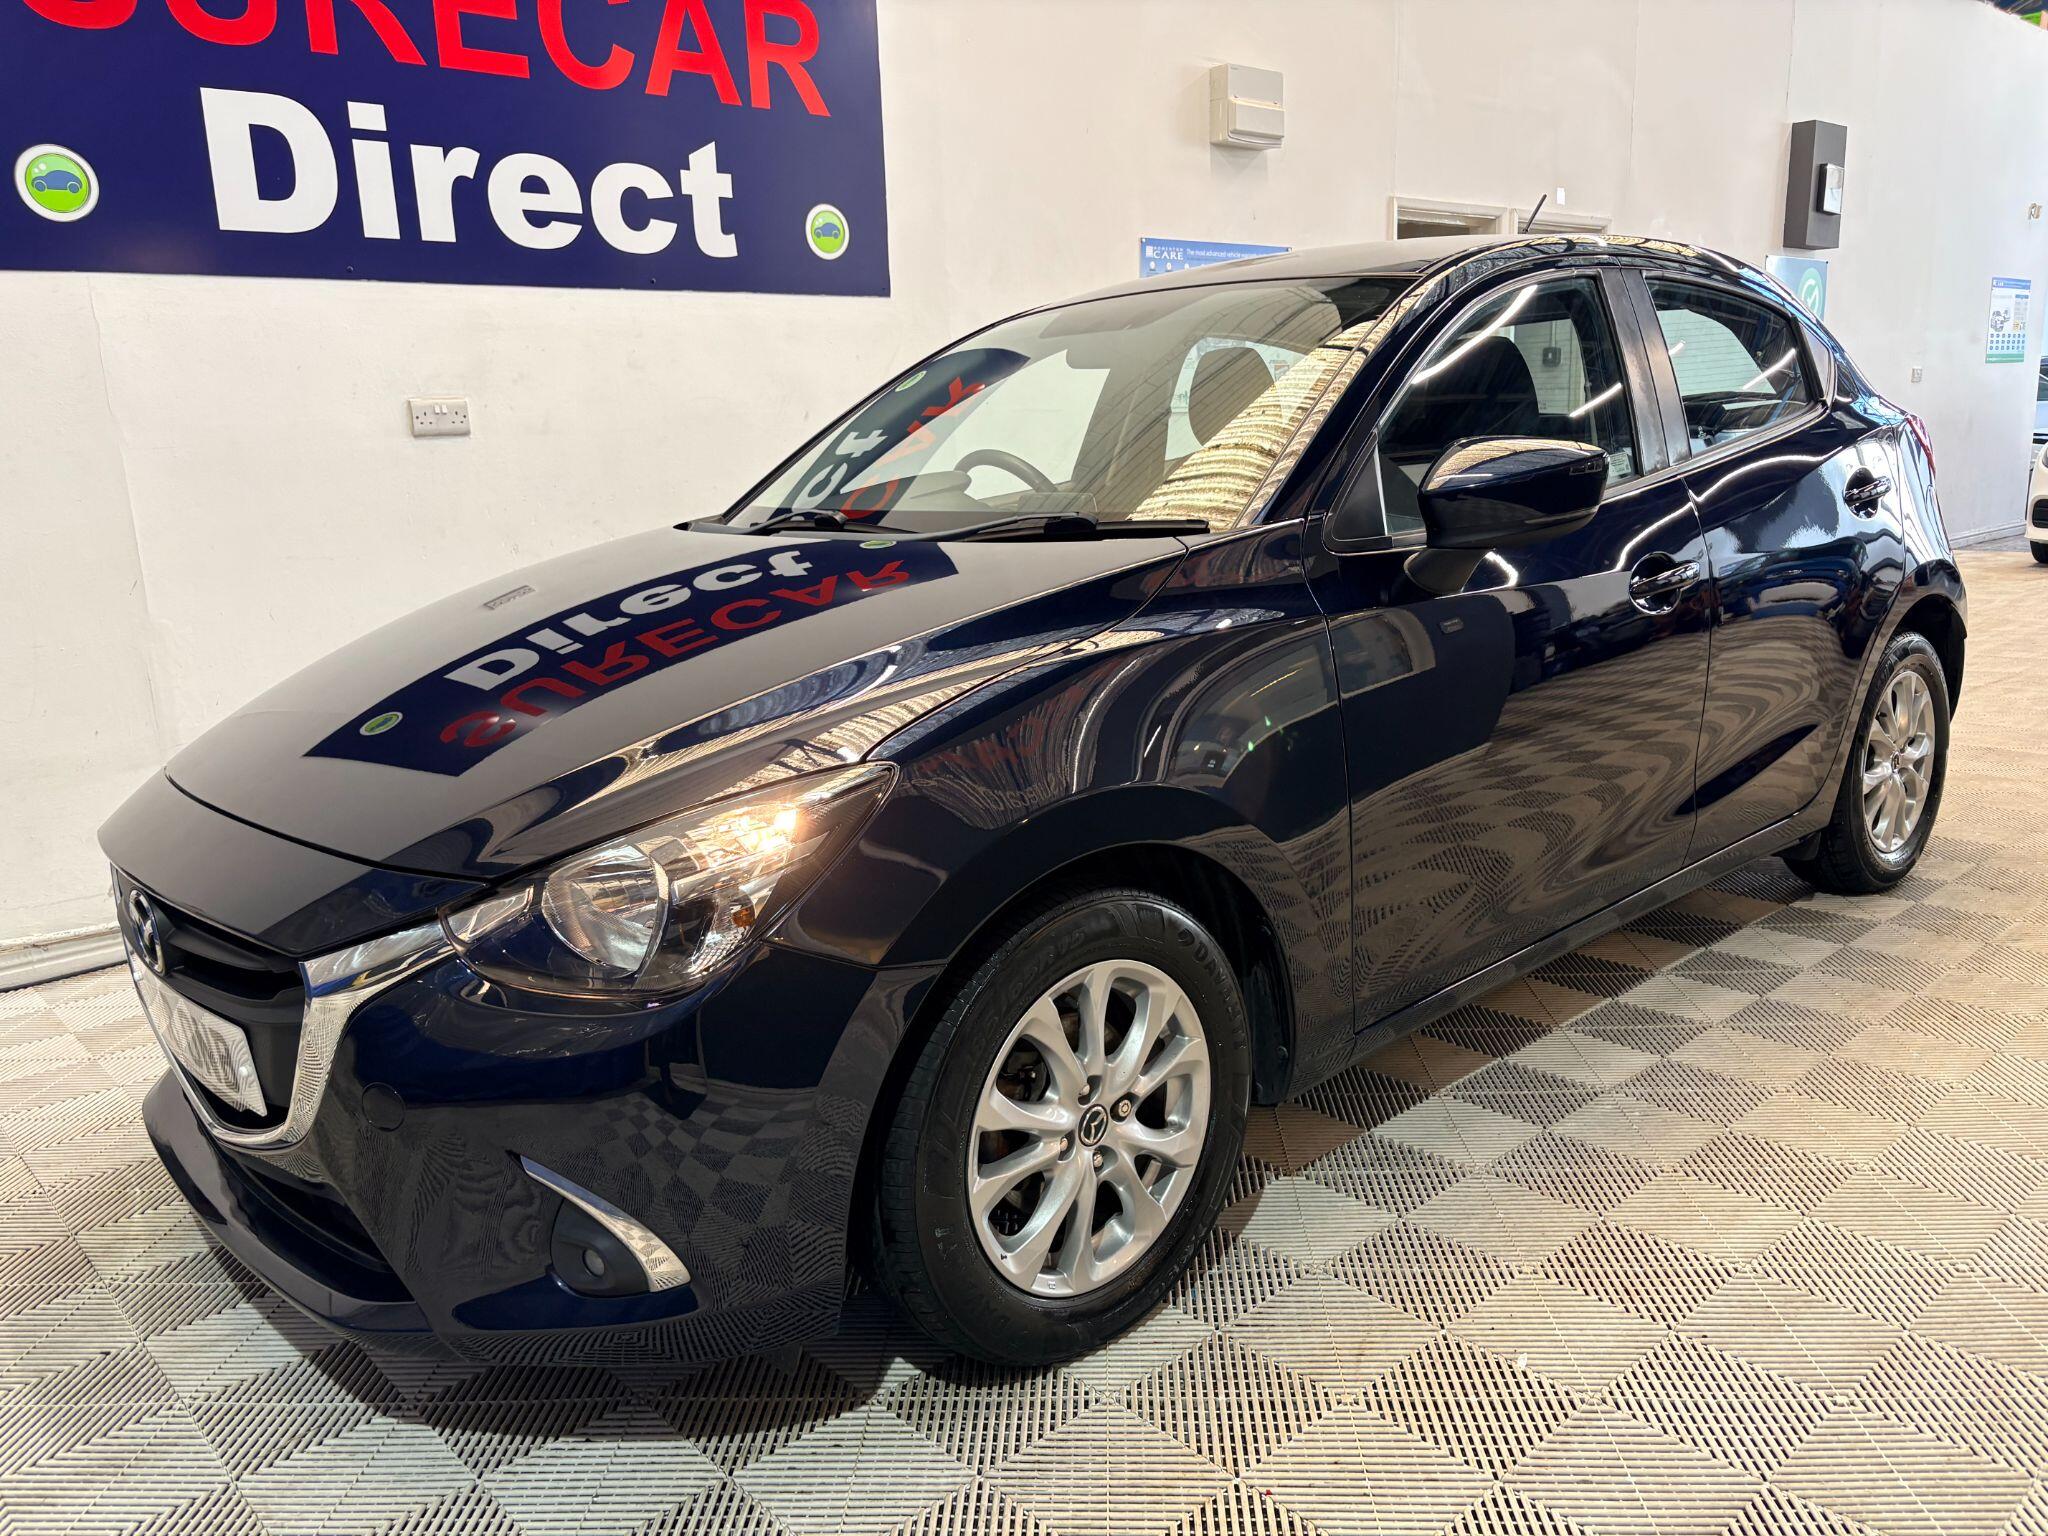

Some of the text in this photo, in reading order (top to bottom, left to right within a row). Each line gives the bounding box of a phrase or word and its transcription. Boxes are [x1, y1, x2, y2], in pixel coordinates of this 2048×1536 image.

[21, 0, 831, 117] RECAR
[200, 86, 739, 259] Direct
[1153, 250, 1184, 260] CARE
